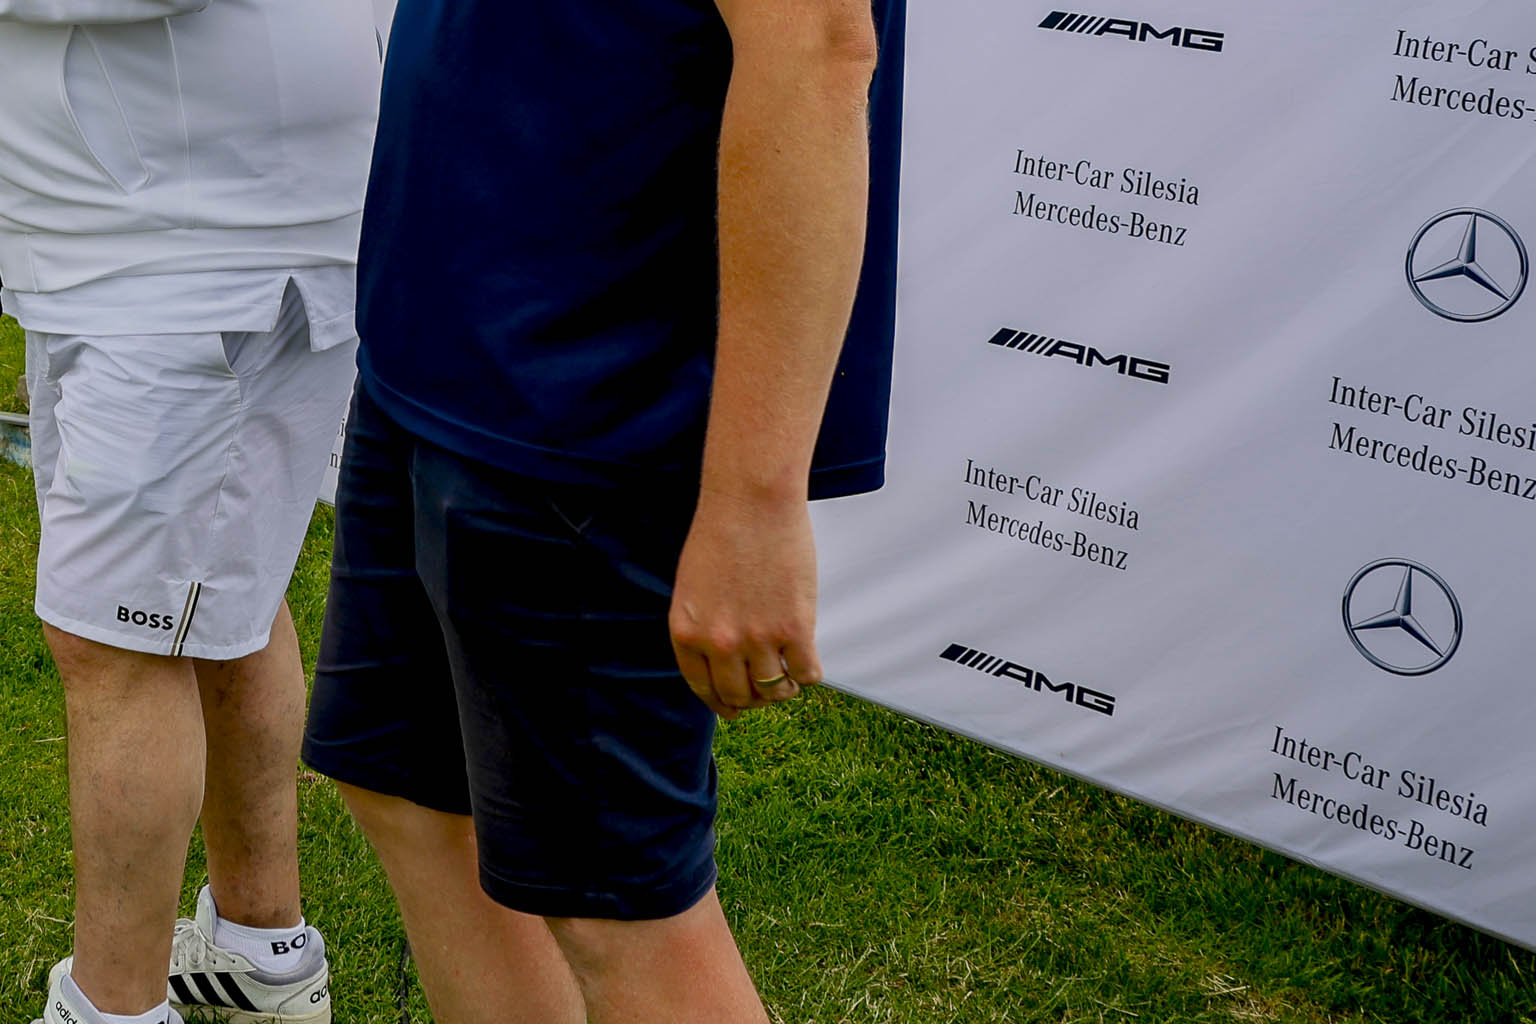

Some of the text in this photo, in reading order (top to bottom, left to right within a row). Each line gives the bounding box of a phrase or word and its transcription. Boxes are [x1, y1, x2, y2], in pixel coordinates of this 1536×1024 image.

[1393, 29, 1518, 72] Inter-Car
[1013, 149, 1200, 205] Inter-Car Silesia
[1013, 190, 1188, 247] Mercedes-Benz
[1328, 376, 1452, 429] Inter-Car
[1328, 422, 1536, 500] Mercedes-Benz
[964, 459, 1140, 530] Inter-Car Silesia
[965, 500, 1128, 570] Mercedes-Benz
[116, 605, 174, 631] BOSS
[1271, 726, 1489, 827] Inter-Car Silesia
[1271, 773, 1474, 869] Mercedes-Benz
